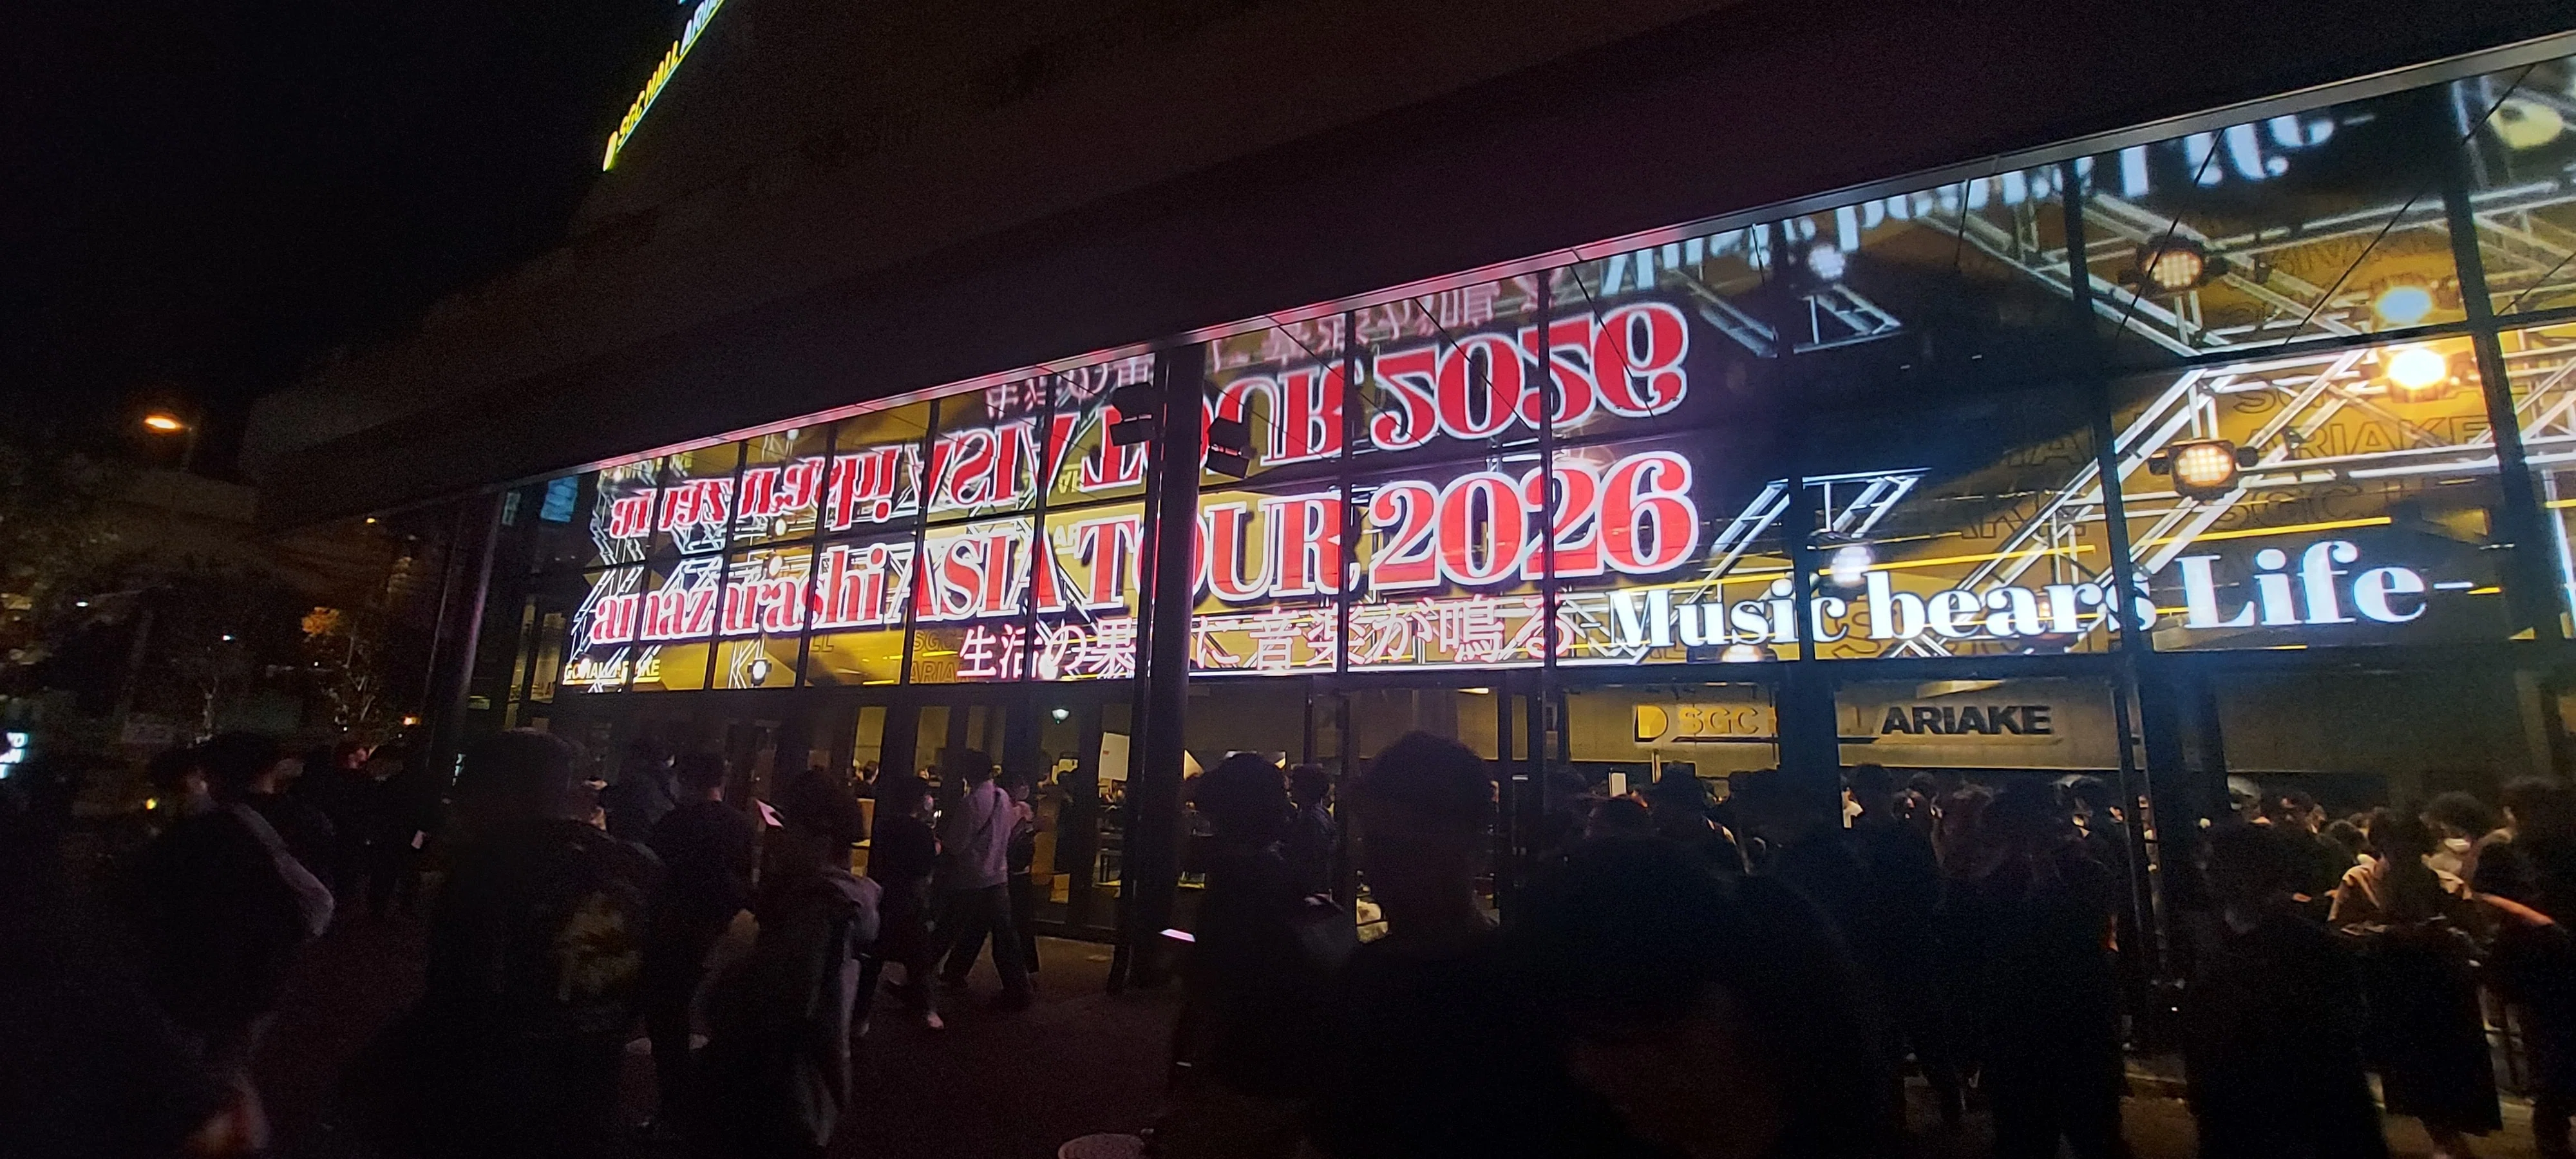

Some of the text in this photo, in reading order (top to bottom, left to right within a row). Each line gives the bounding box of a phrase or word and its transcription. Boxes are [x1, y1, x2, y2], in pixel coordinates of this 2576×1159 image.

[884, 523, 1066, 623] ASIA
[1075, 492, 1359, 612] TUR
[1369, 451, 1700, 592] 2026
[957, 594, 1573, 680] 生活の果に音楽が鳴る
[1861, 571, 2156, 643] bears
[2175, 541, 2473, 629] Life-
[1680, 706, 1759, 736] SGC
[1880, 705, 2052, 736] ARIAKE
